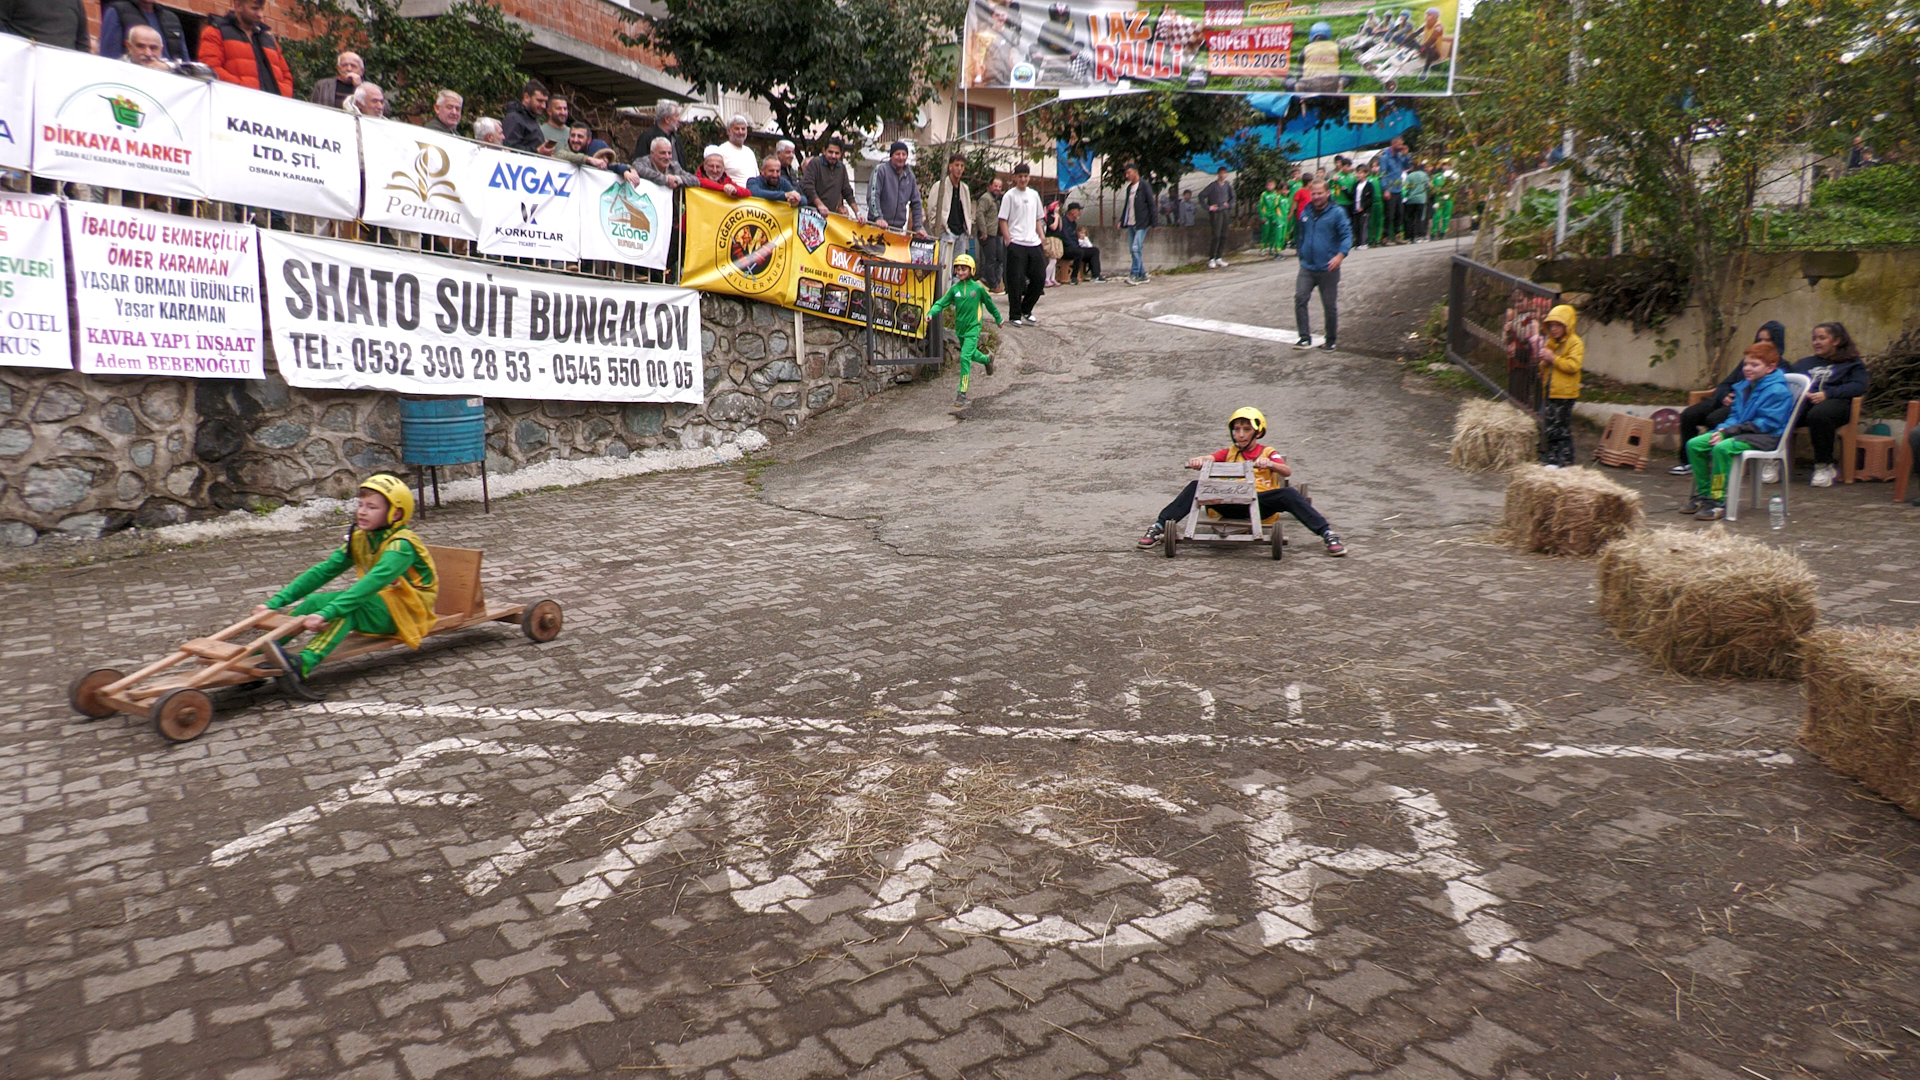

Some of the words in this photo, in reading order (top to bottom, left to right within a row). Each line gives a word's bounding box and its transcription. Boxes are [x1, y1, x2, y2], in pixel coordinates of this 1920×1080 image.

[1089, 10, 1152, 48] LAZ
[1209, 33, 1250, 51] SÜPER
[1212, 53, 1287, 69] 31.10.2026
[43, 124, 122, 154] DİKKAYA
[125, 138, 192, 165] MARKET
[227, 116, 342, 154] KARAMANLAR
[93, 154, 127, 167] KARAMAN
[136, 162, 160, 173] ORHAN
[160, 166, 191, 177] KARAMAN
[253, 144, 288, 164] LTD.
[291, 152, 321, 169] ŞTİ.
[249, 165, 281, 178] OSMAN
[282, 172, 325, 186] KARAMAN
[488, 161, 573, 198] AYGAZ
[385, 195, 461, 225] Peruma
[81, 211, 156, 243] İBALOĞLU
[162, 226, 249, 255] EKMEKÇİLİK
[495, 226, 564, 242] KORKUTLAR
[611, 221, 649, 243] Zifona
[719, 210, 745, 249] CİĞERCİ
[746, 208, 778, 231] MURAT
[107, 242, 153, 270] ÖMER
[159, 252, 229, 277] KARAMAN
[831, 248, 853, 269] RAY
[80, 270, 130, 294] YAŞAR
[134, 275, 186, 300] ORMAN
[191, 278, 254, 303] ÜRÜNLERİ
[115, 297, 155, 320] Yaşar
[159, 301, 226, 324] KARAMAN
[283, 258, 421, 331] SHATO
[435, 273, 518, 336] SUİT
[529, 289, 690, 351] BUNGALOV
[8, 311, 62, 332] OTEL
[86, 327, 147, 347] KAVRA
[150, 332, 191, 350] YAPI
[196, 331, 256, 354] İNŞAAT
[95, 352, 142, 370] Adem
[146, 354, 250, 374] BEBENOĞLU
[289, 332, 343, 370] TEL:
[351, 337, 415, 375] 0532
[420, 344, 465, 380] 390
[471, 348, 498, 381] 28
[505, 350, 532, 383] 53
[552, 353, 602, 386] 0545
[607, 357, 641, 388] 550
[646, 359, 669, 388] 00
[673, 360, 694, 389] 05
